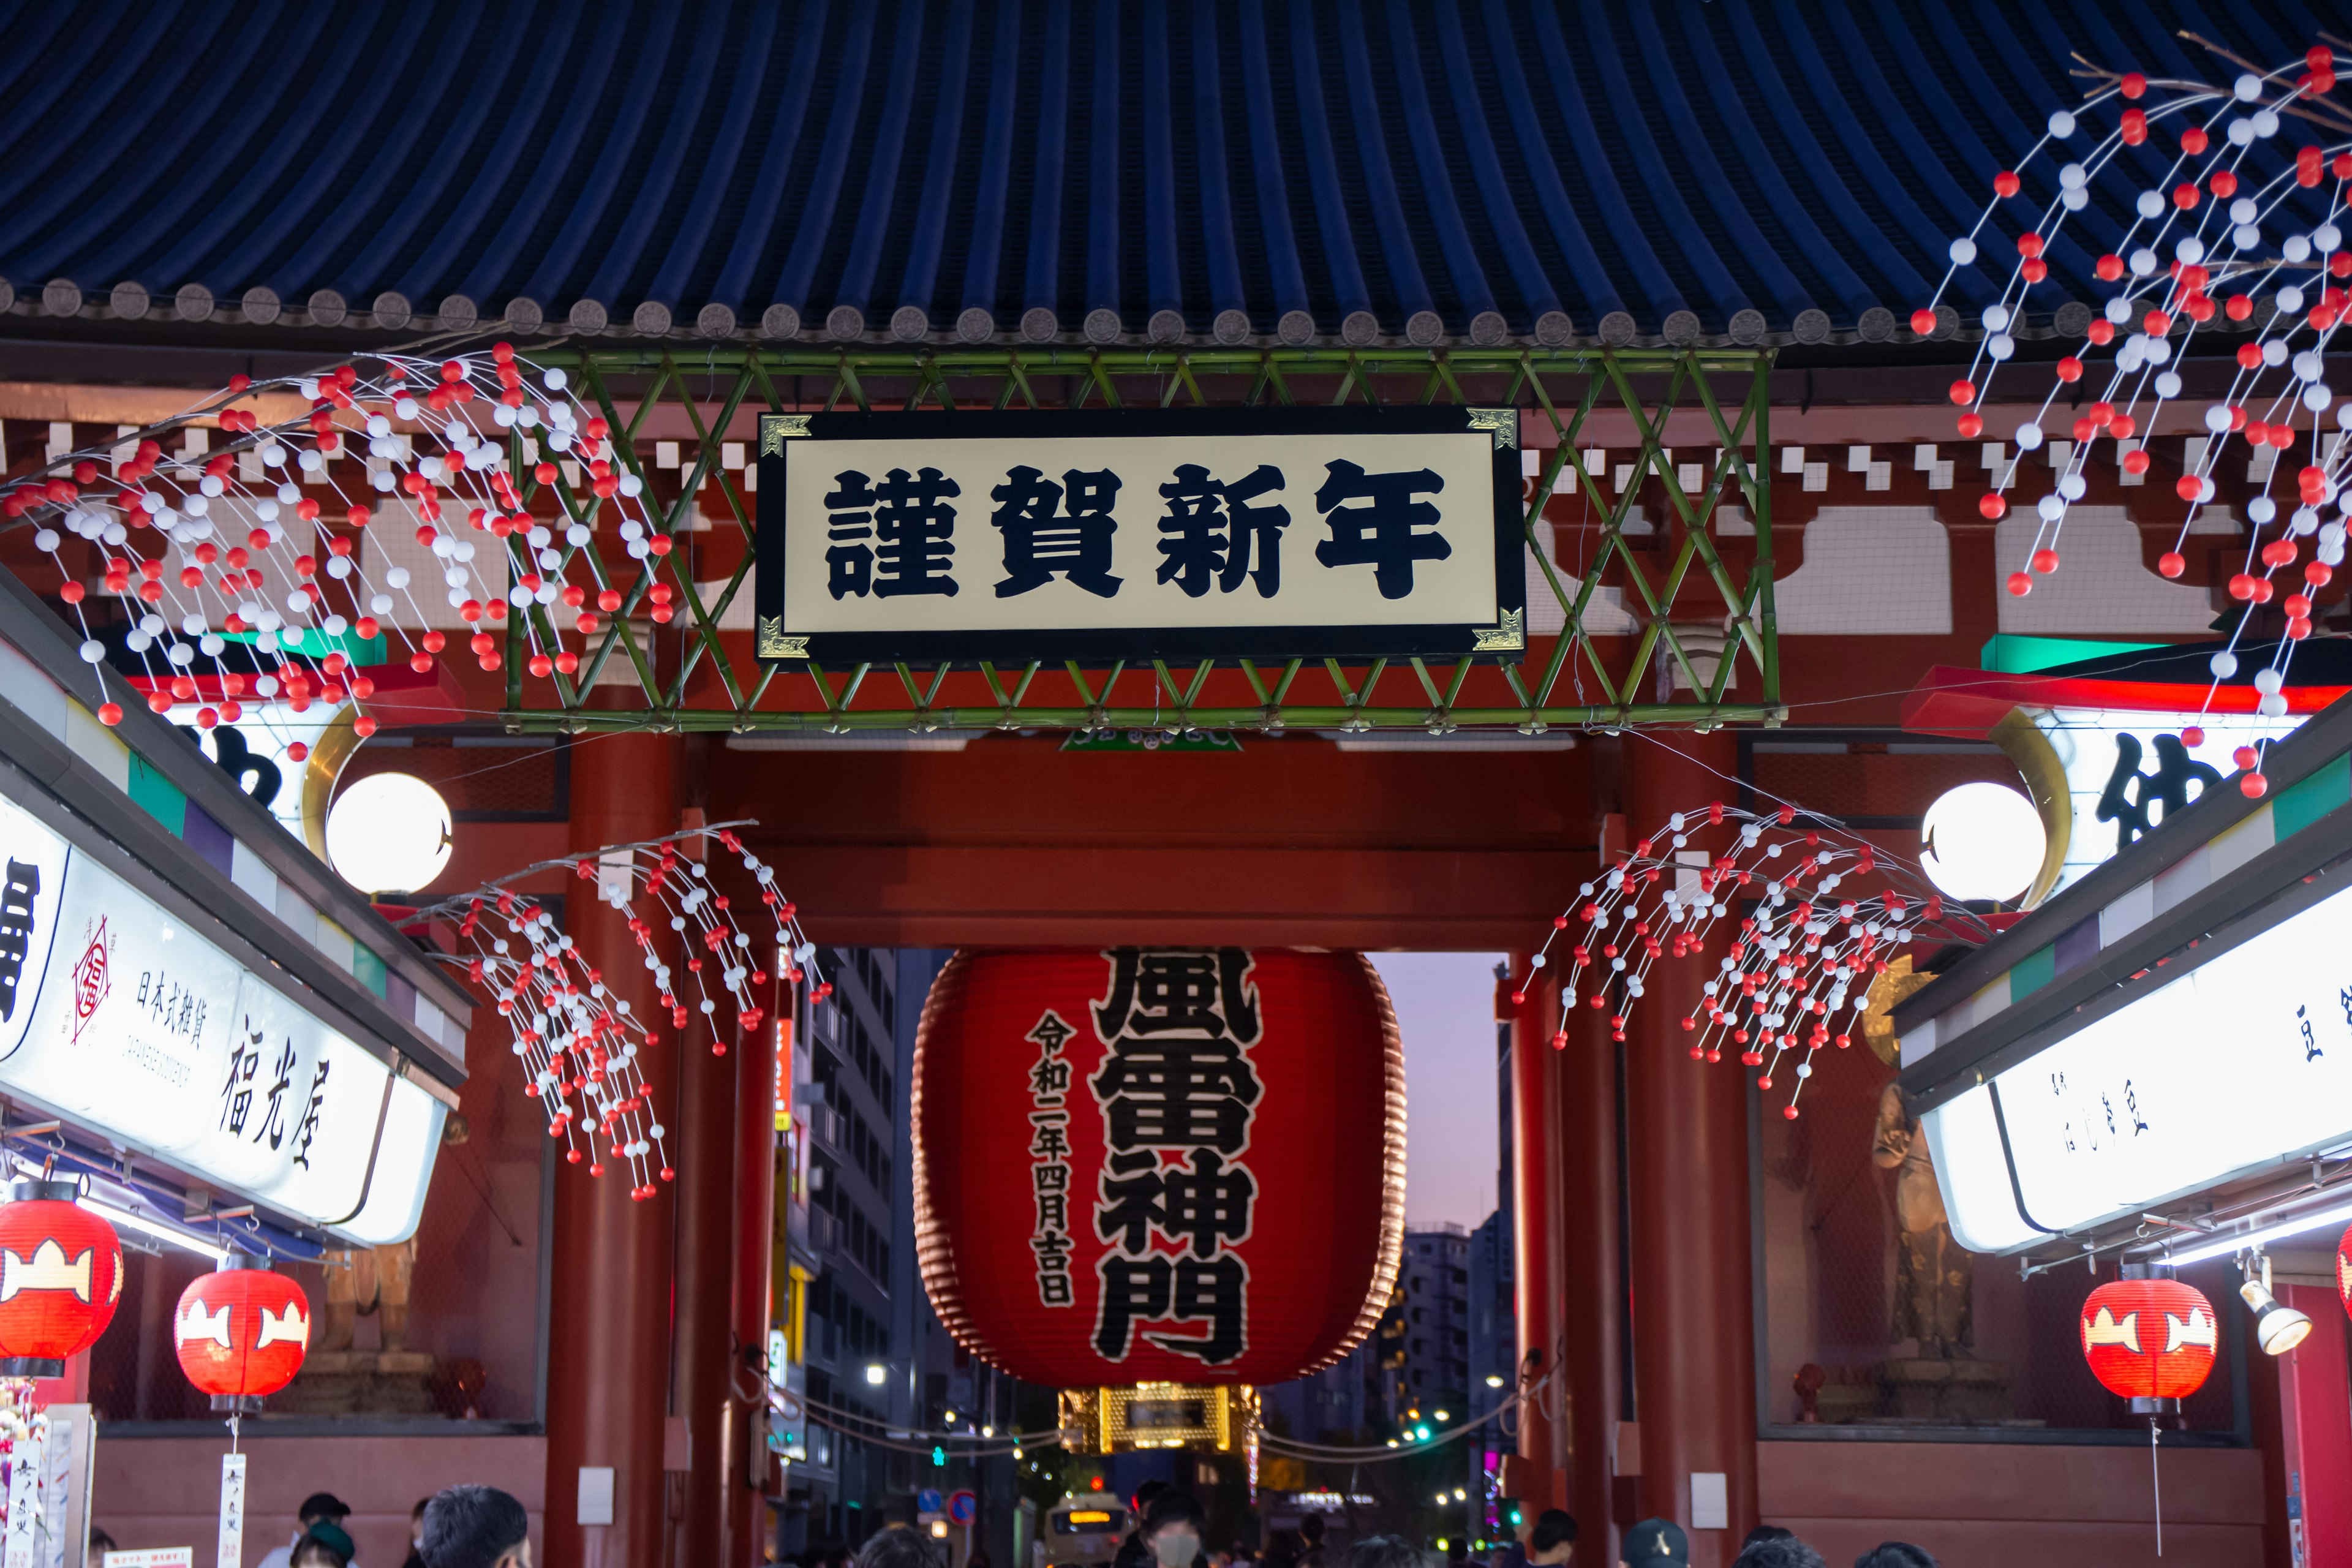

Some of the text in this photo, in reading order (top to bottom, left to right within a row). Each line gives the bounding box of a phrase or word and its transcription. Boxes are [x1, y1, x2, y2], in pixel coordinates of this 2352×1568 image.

[823, 458, 1452, 601] 謹賀新年
[80, 952, 105, 1009] 福
[137, 970, 206, 1050] 日本式雑貨
[219, 1014, 329, 1172] 福光屋
[1025, 1008, 1077, 1308] 令和二年四月吉日
[1089, 947, 1265, 1365] 風雷神門
